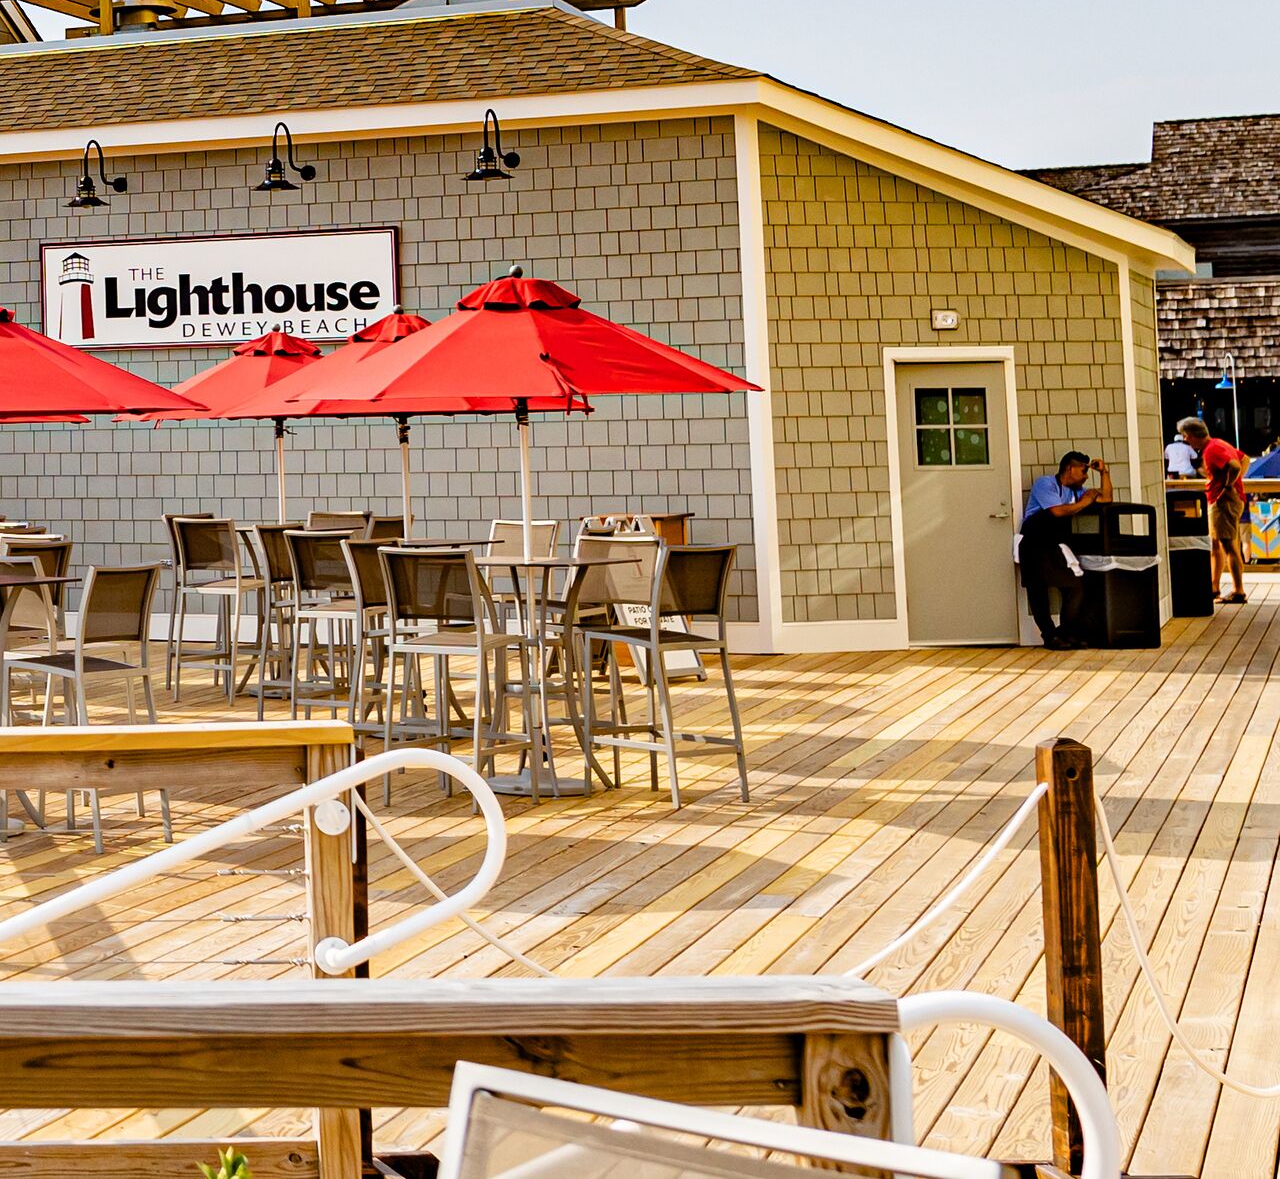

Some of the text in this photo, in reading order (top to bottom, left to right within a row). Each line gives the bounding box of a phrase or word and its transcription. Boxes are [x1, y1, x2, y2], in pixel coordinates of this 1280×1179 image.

[128, 267, 165, 281] THE
[104, 272, 381, 328] Lighthouse
[183, 318, 368, 338] DEWEY BEACH
[627, 606, 646, 614] PATIO
[634, 617, 648, 625] FOR
